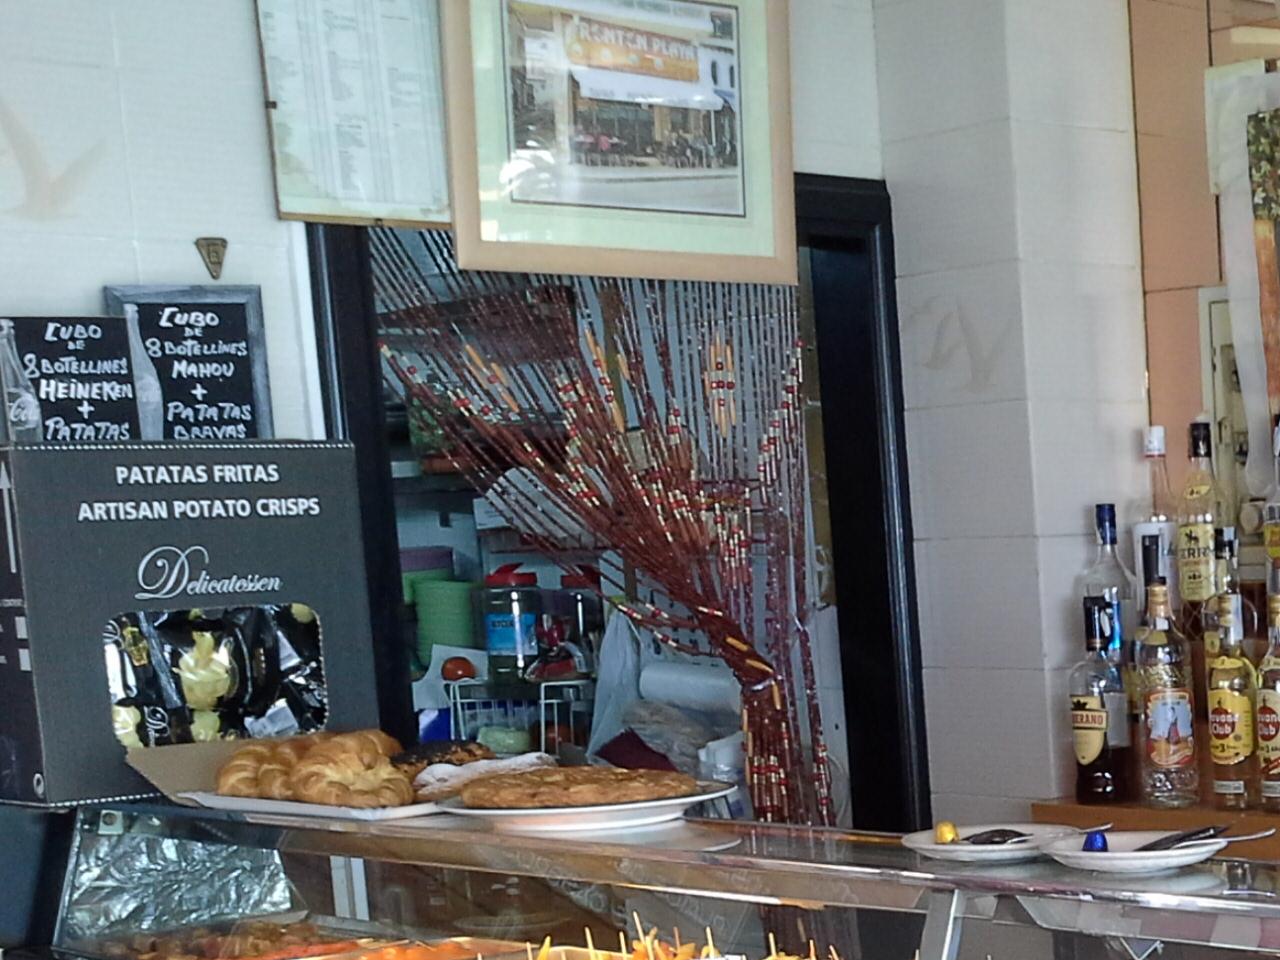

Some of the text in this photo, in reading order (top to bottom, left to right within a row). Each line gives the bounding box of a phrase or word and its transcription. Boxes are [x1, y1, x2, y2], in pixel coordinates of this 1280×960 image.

[159, 307, 220, 327] CUBO
[44, 322, 102, 342] CUBO
[145, 338, 248, 358] 8 BOTELLINES
[23, 353, 128, 379] 8 BOTELLINES
[172, 360, 235, 379] MAHOU
[38, 378, 134, 402] HEINEKEN
[167, 401, 252, 423] PATATAS
[44, 416, 130, 442] PATATAS
[174, 423, 247, 440] BRAVAS
[115, 464, 280, 485] PATATAS FRITAS
[77, 498, 320, 521] ARTISAN POTATO CRISPS
[134, 546, 282, 600] Delicatessen
